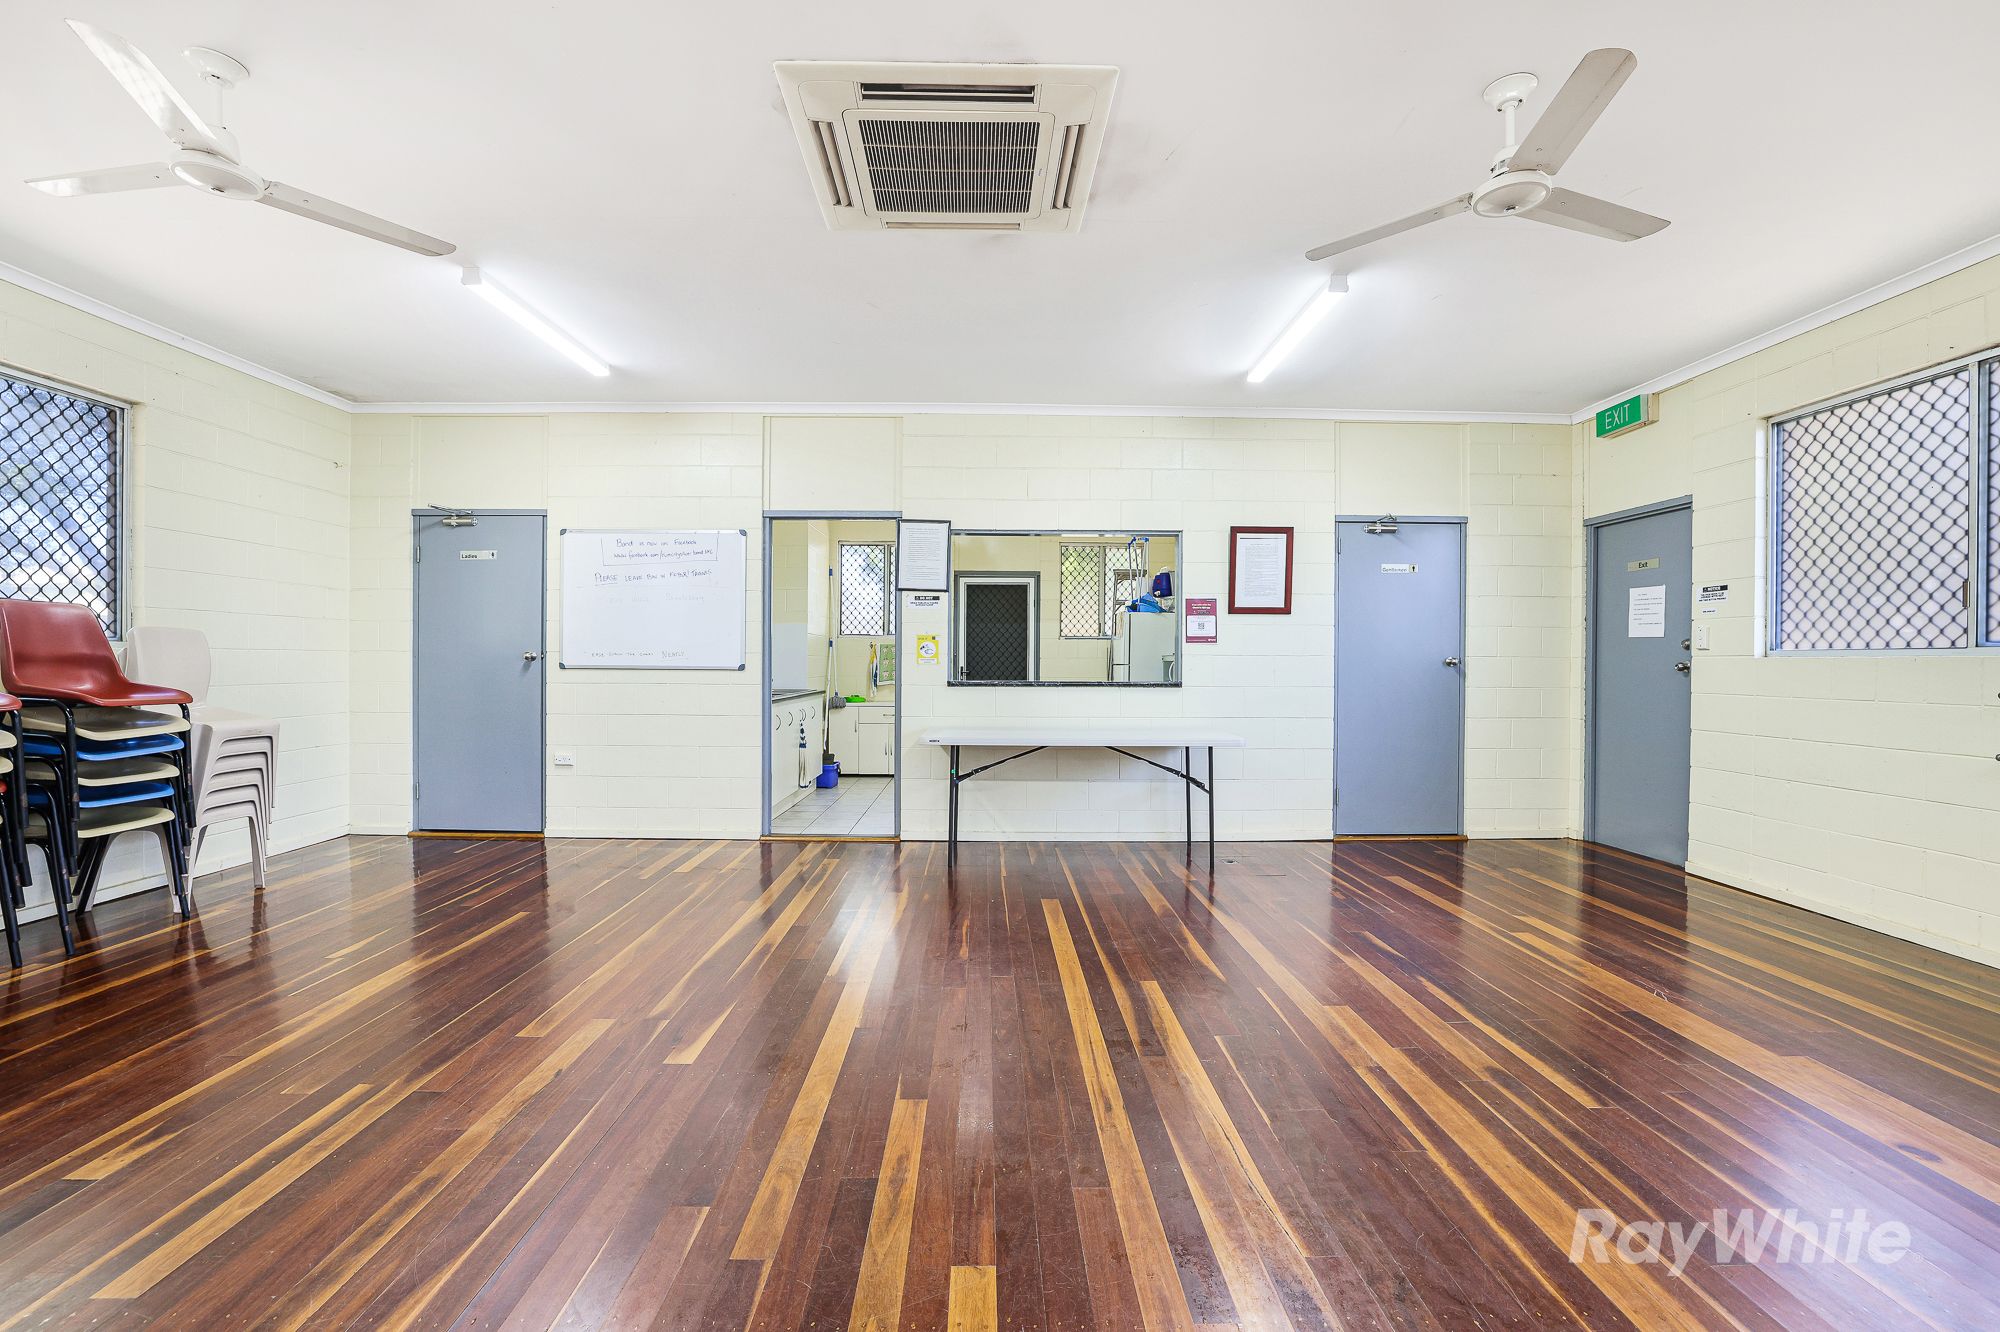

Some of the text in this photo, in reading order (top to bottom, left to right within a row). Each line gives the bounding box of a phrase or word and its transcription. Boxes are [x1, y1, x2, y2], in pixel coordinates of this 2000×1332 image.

[1605, 403, 1631, 430] EXIT
[616, 538, 633, 548] Band
[1638, 561, 1649, 569] Exit
[1382, 566, 1407, 574] Gentlemen
[594, 571, 618, 583] PLEASE
[661, 650, 686, 659] NEATLY
